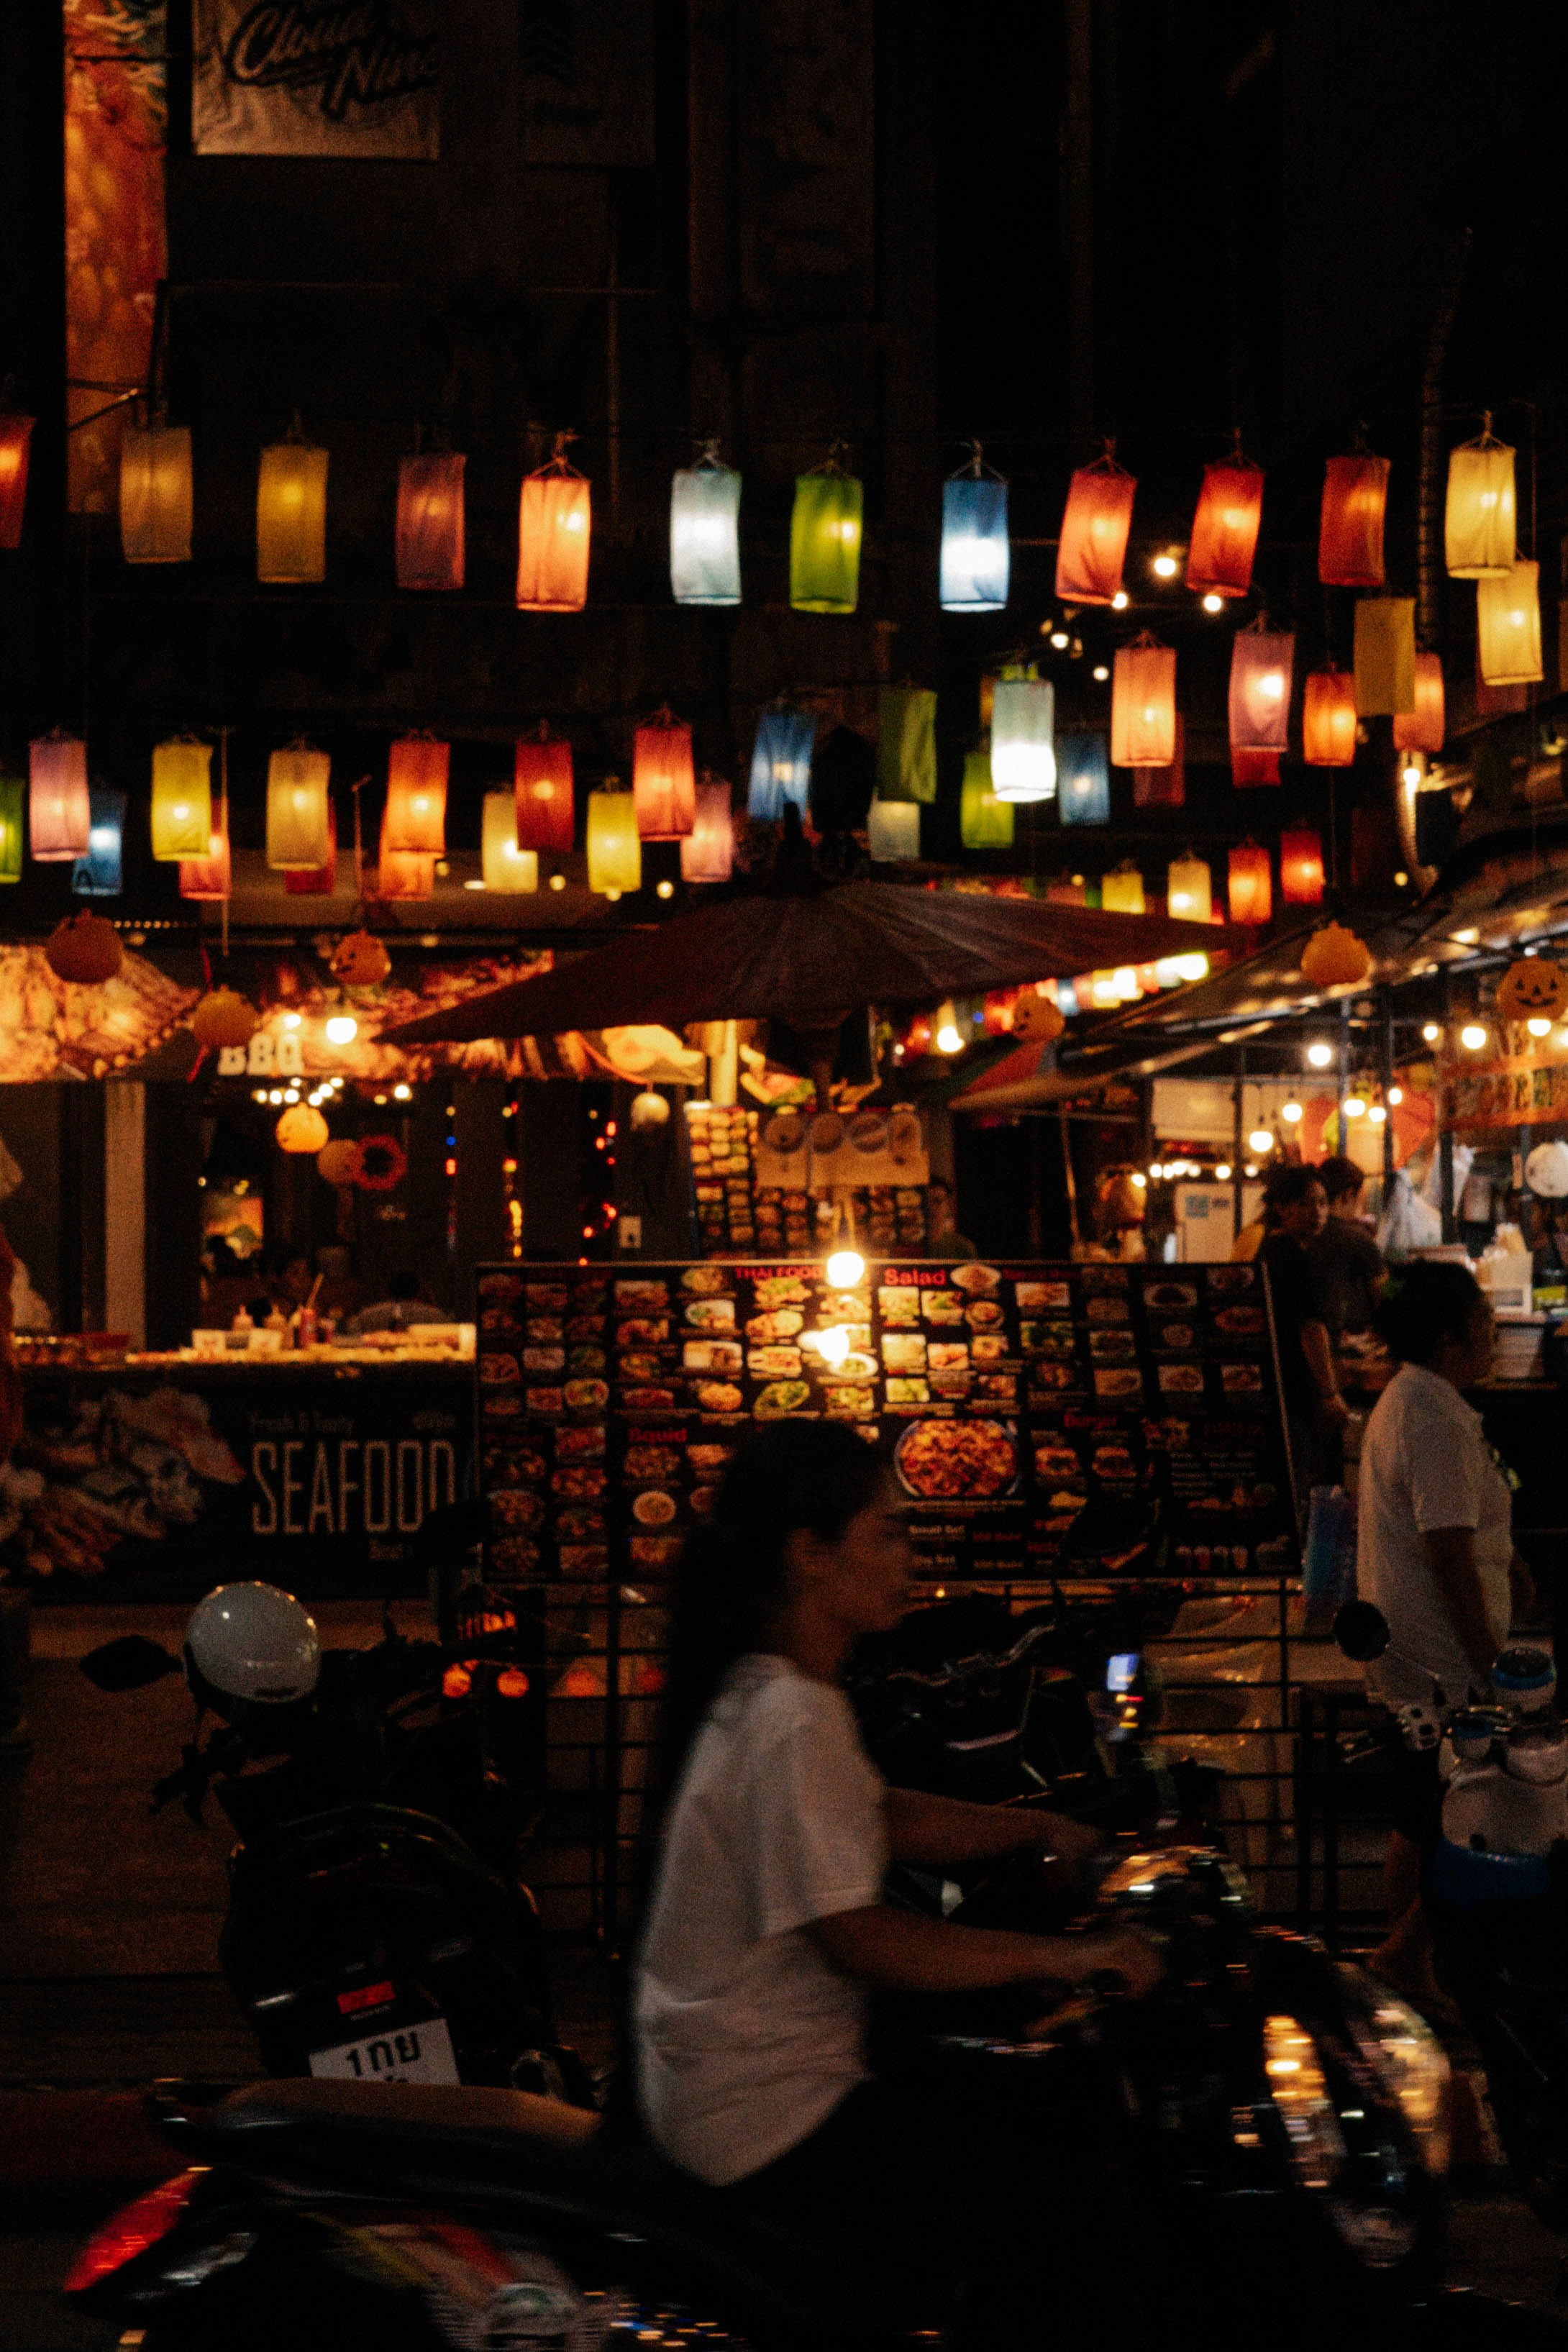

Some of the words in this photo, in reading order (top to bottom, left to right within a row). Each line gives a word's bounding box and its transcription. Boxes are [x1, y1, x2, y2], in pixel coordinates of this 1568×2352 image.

[227, 0, 378, 84] Cloud
[884, 1267, 947, 1286] Salad
[628, 1427, 688, 1444] Squid
[252, 1439, 456, 1535] SEAFOOD
